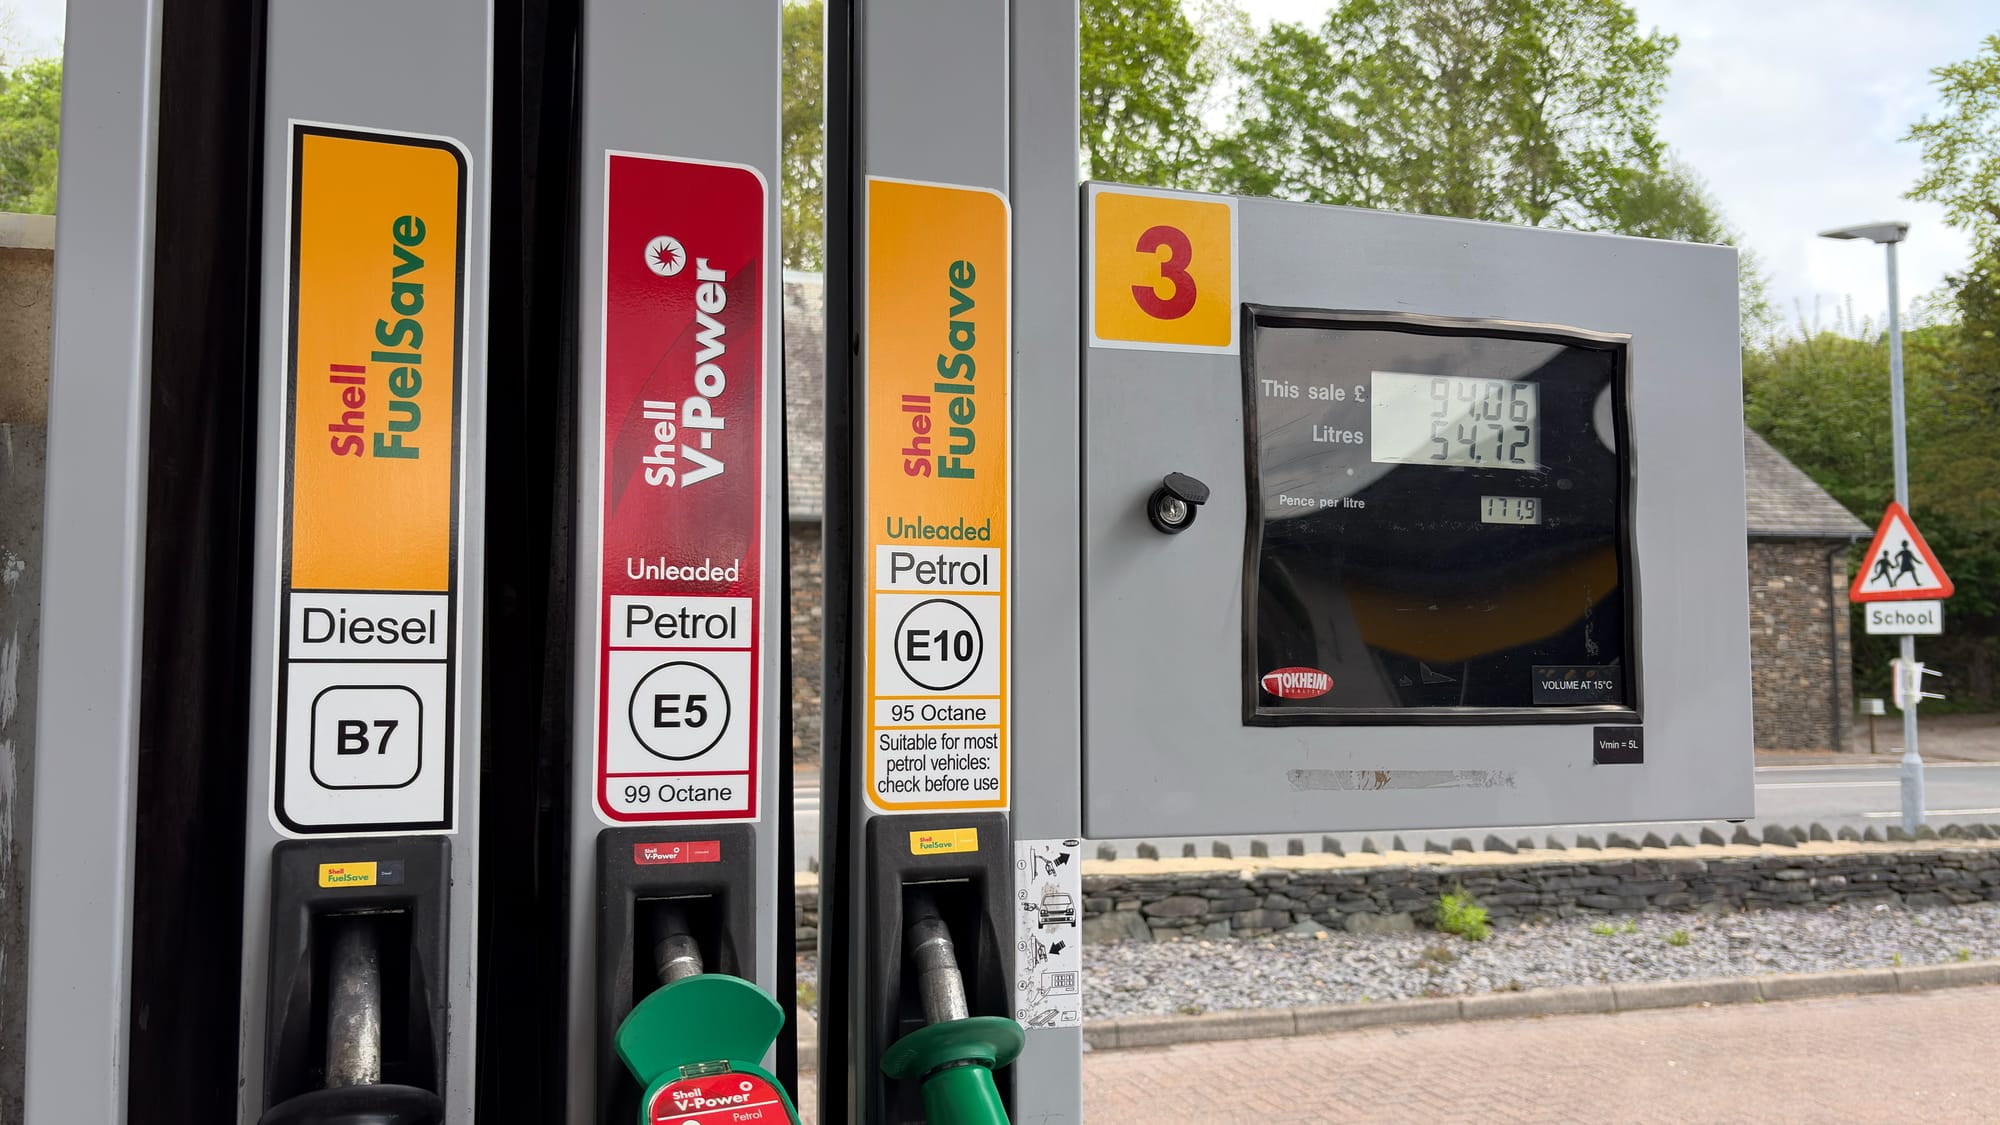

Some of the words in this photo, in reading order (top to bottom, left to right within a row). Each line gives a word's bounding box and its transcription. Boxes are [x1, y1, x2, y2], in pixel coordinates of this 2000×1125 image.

[1131, 225, 1197, 320] 3
[371, 214, 427, 460] FuelSave
[681, 257, 727, 489] V-Power
[934, 260, 976, 479] FuelSave
[1261, 379, 1300, 400] This
[1308, 382, 1346, 402] sale
[1353, 385, 1366, 403] £
[328, 363, 367, 458] Shell
[643, 400, 676, 488] Shell
[902, 394, 931, 479] Shell
[1312, 424, 1364, 445] Litres
[1279, 494, 1315, 508] Pence
[1319, 497, 1339, 510] per
[1343, 497, 1366, 510] litre
[886, 516, 991, 541] Unleaded
[627, 556, 739, 582] Unleaded
[891, 552, 988, 586] Petrol
[302, 607, 436, 645] Diesel
[626, 604, 736, 639] Petrol
[1873, 610, 1933, 625] School
[907, 630, 974, 661] E10
[1261, 672, 1328, 697] TOKHEIM
[1542, 681, 1580, 690] VOLUME
[1580, 681, 1591, 690] AT
[1593, 680, 1613, 690] 15°C
[653, 693, 708, 729] E5
[891, 704, 915, 722] 95
[921, 704, 987, 721] Octane
[337, 719, 399, 755] B7
[879, 733, 937, 751] Suitable
[941, 732, 960, 750] for
[964, 732, 999, 749] most
[1600, 740, 1620, 749] Vmin
[1628, 740, 1638, 749] 5L
[887, 754, 926, 776] petrol
[931, 753, 990, 771] vehicles:
[624, 784, 649, 804] 99
[658, 783, 732, 803] Octane
[878, 775, 920, 793] check
[925, 775, 969, 792] before
[974, 777, 999, 791] use
[920, 841, 952, 849] FuelSave
[328, 874, 369, 882] FuelSave
[673, 1088, 702, 1099] Shell
[674, 1093, 751, 1112] V-Power
[733, 1109, 763, 1122] Petrol
